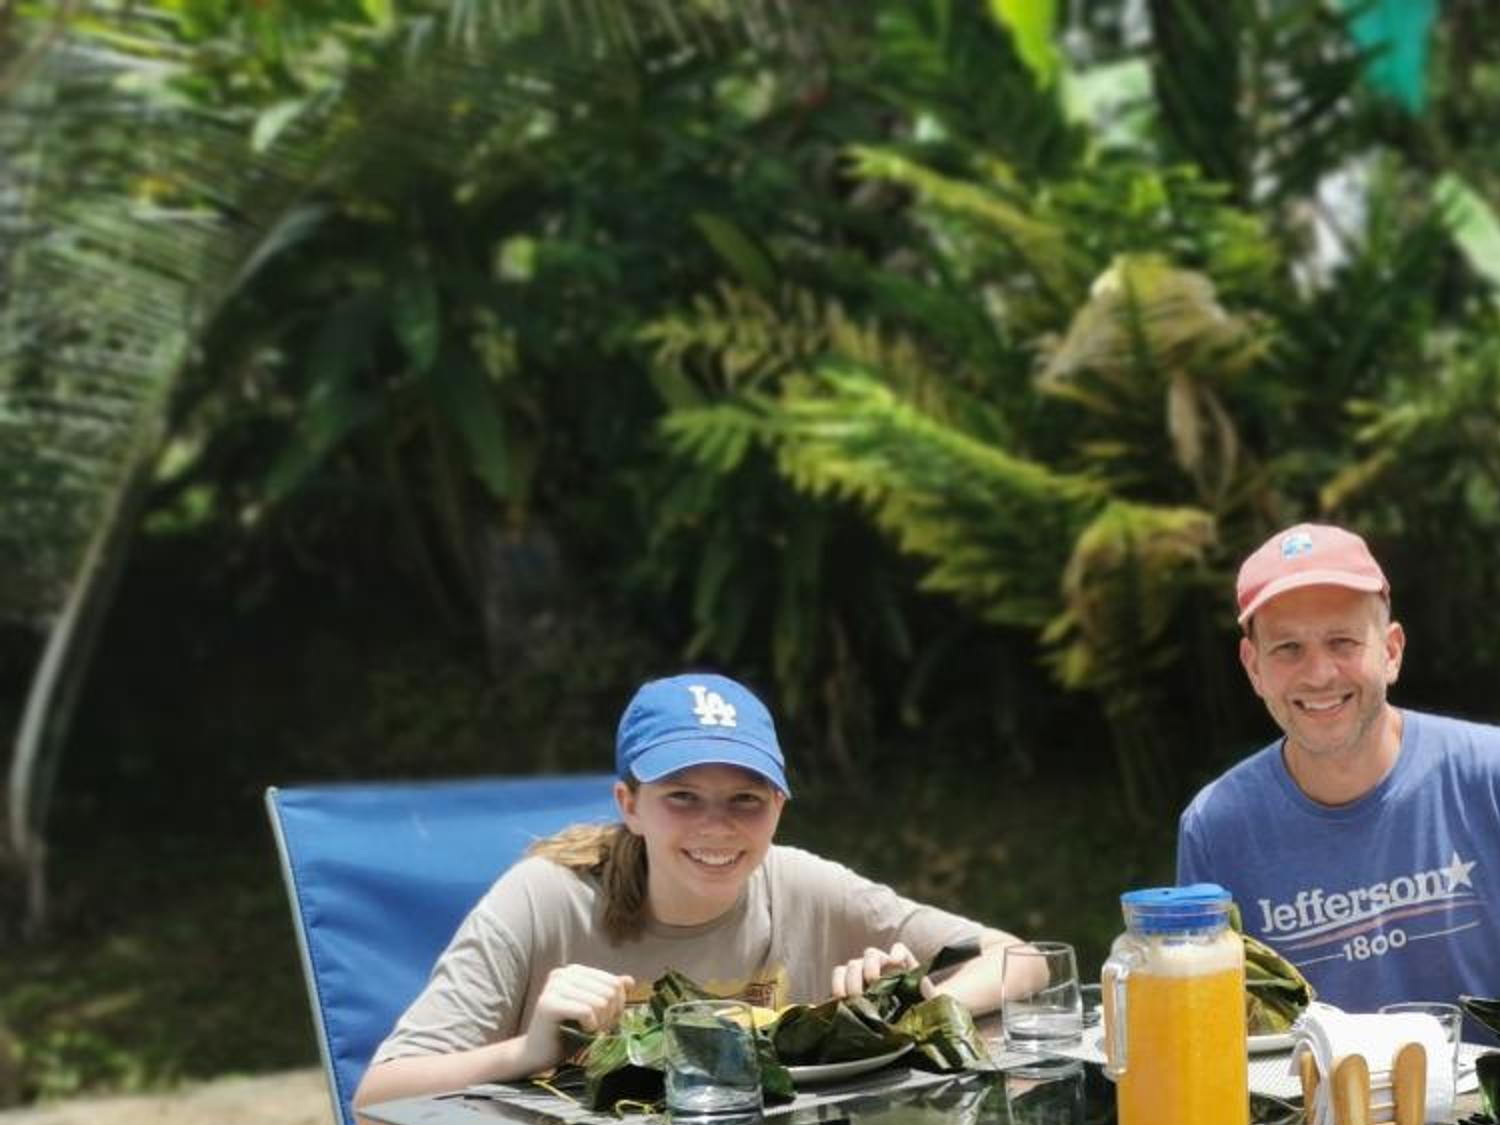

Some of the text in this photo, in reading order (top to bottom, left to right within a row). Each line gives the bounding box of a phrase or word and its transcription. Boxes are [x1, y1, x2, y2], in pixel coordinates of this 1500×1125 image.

[687, 685, 737, 727] LA
[1258, 868, 1446, 933] Jefferson
[1343, 929, 1407, 962] 1800
